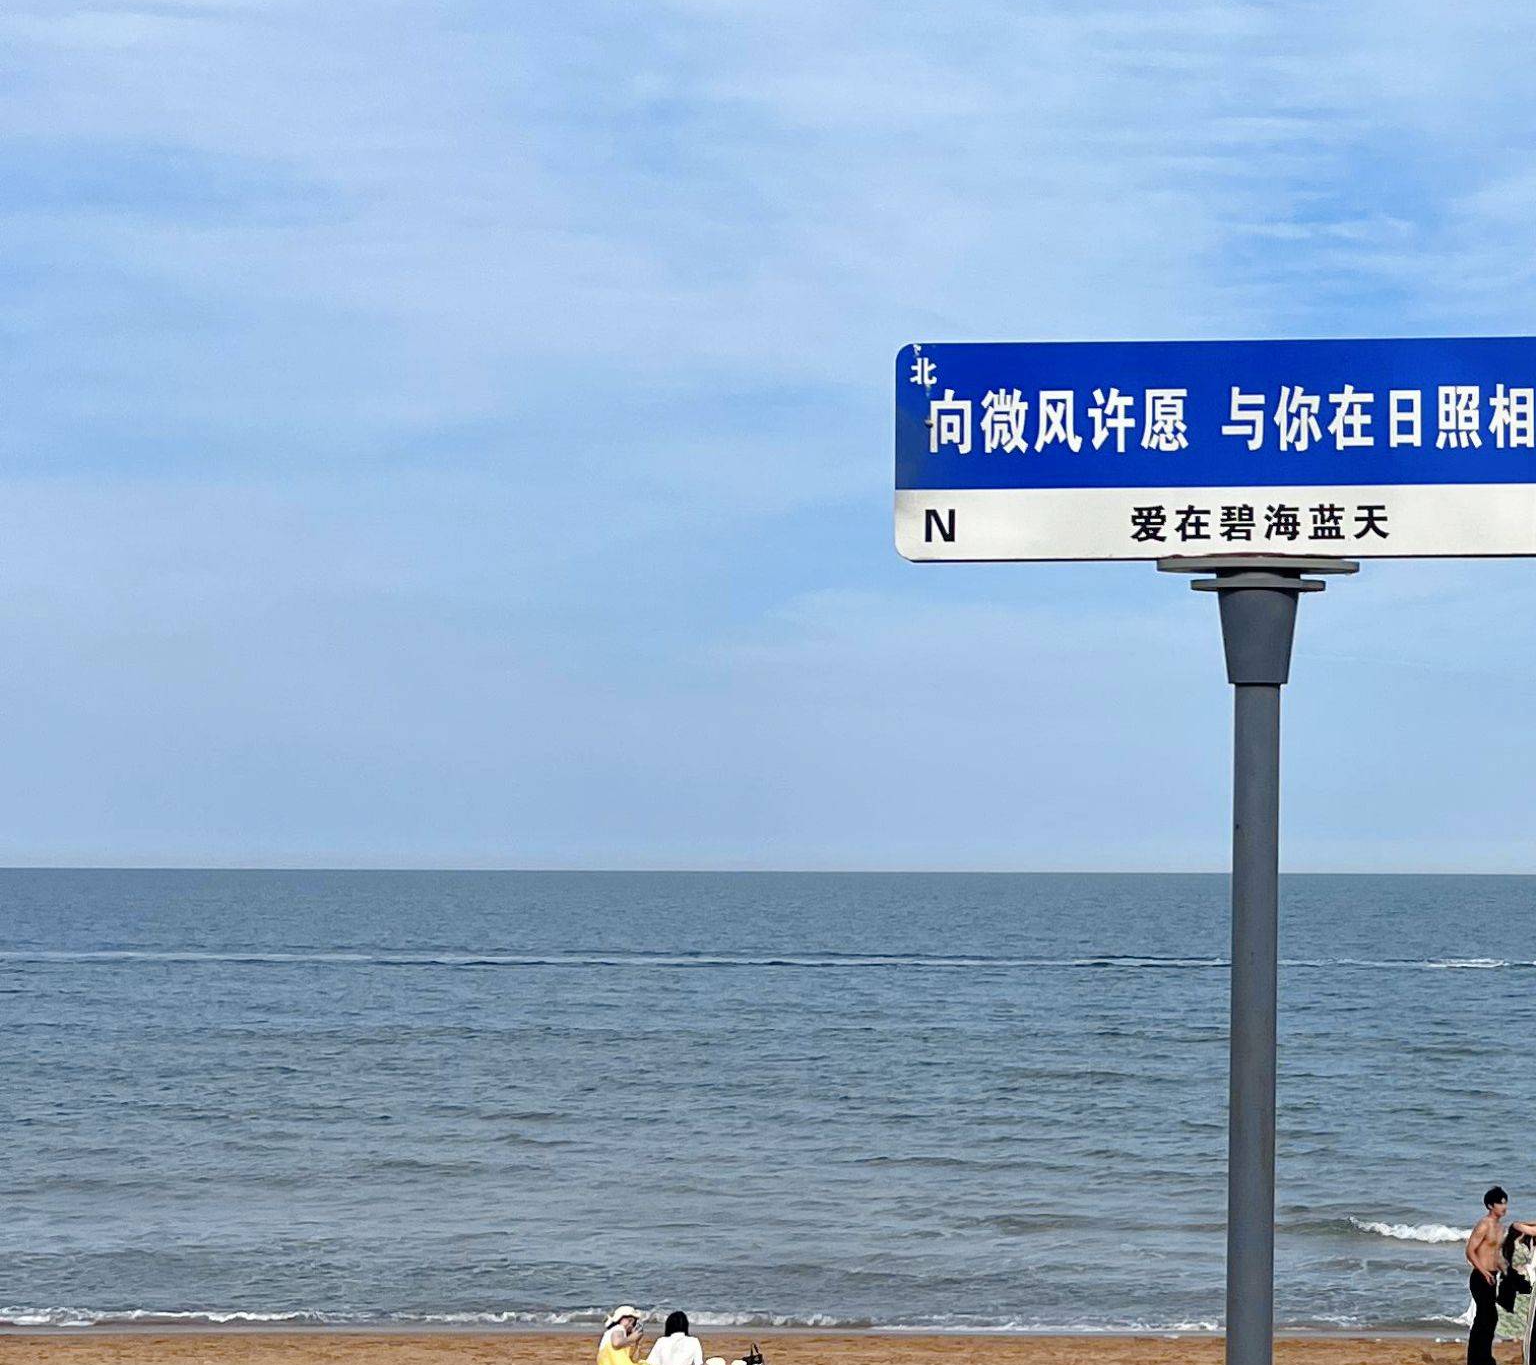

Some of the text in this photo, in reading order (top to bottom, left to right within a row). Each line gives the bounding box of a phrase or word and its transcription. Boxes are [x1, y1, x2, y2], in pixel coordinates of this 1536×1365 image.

[910, 357, 937, 385] 北
[928, 387, 1189, 454] 向微风许愿
[924, 508, 956, 543] N
[1130, 503, 1390, 543] 爱在碧海蓝天
